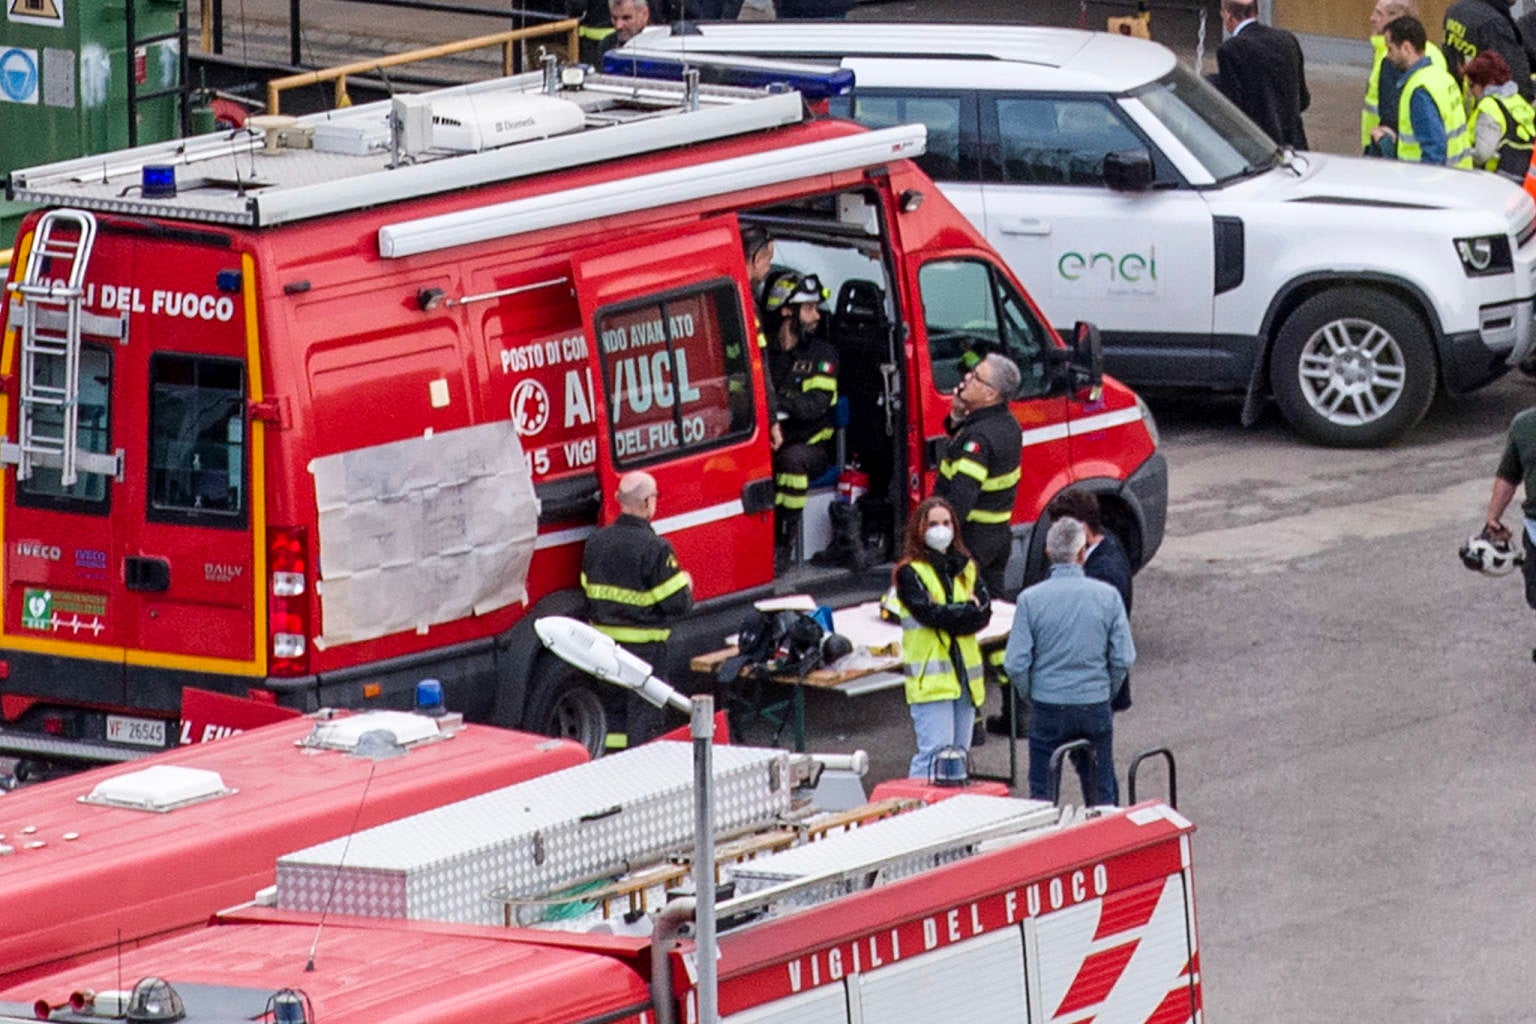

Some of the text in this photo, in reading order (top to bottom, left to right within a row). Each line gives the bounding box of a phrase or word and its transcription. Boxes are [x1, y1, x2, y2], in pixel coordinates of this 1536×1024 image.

[1058, 245, 1157, 282] enel
[101, 284, 146, 312] DEL
[152, 290, 234, 322] FUOCO
[500, 342, 545, 374] POSTO
[545, 340, 562, 366] DI
[614, 429, 648, 457] DEL
[17, 542, 61, 561] IVECO
[109, 719, 122, 736] VF
[788, 864, 1108, 993] VIGILI DEL FUOCO
